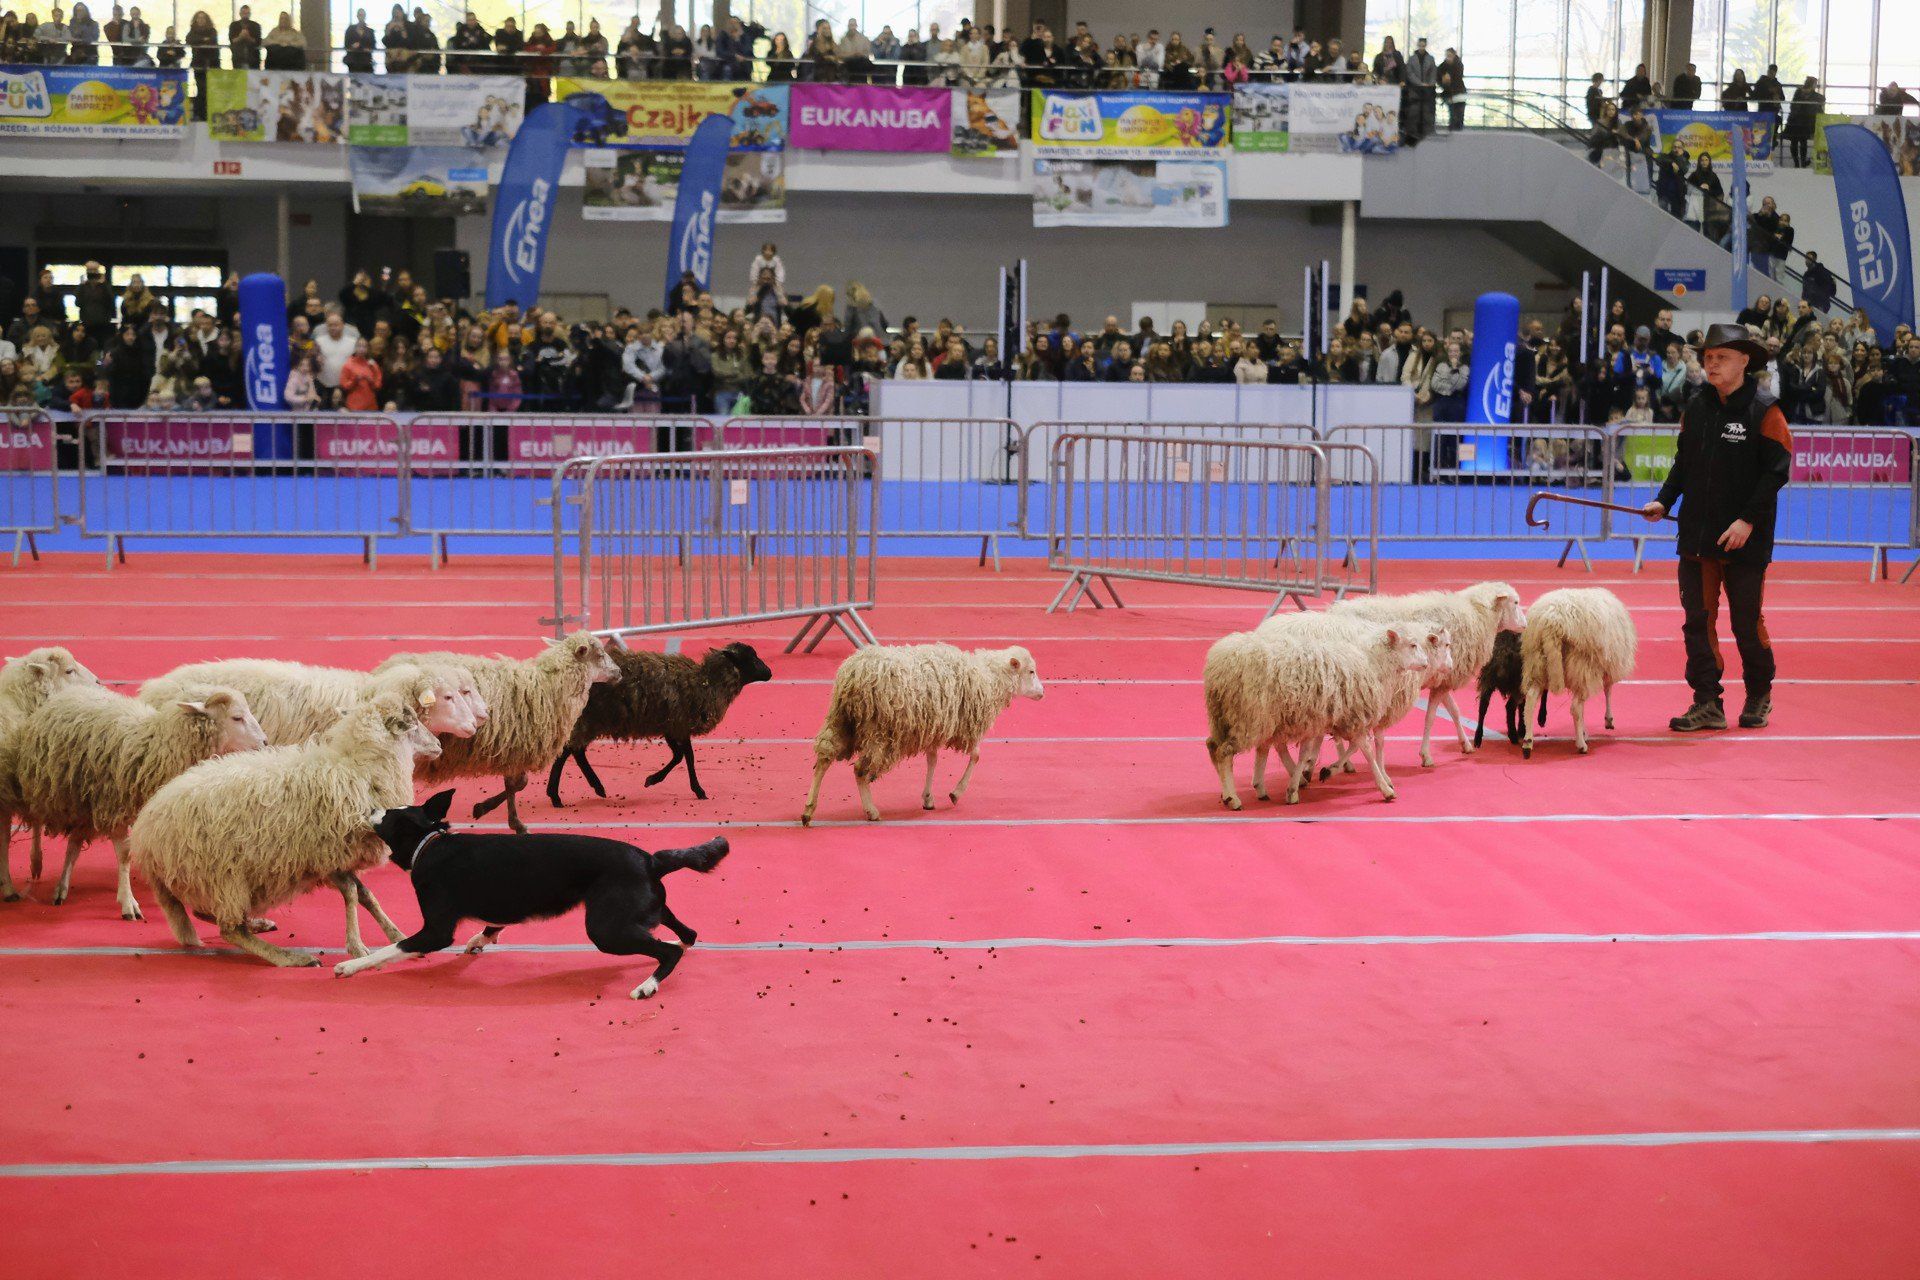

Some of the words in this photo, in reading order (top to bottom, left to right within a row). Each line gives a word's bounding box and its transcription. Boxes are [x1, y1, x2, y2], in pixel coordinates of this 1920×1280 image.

[626, 103, 716, 134] Czajk
[801, 106, 941, 129] EUKANUBA
[1048, 117, 1096, 133] FUN
[517, 177, 551, 273] Enea
[255, 322, 278, 404] Enea
[1494, 342, 1516, 418] Enea
[1795, 452, 1898, 468] EUKANUBA
